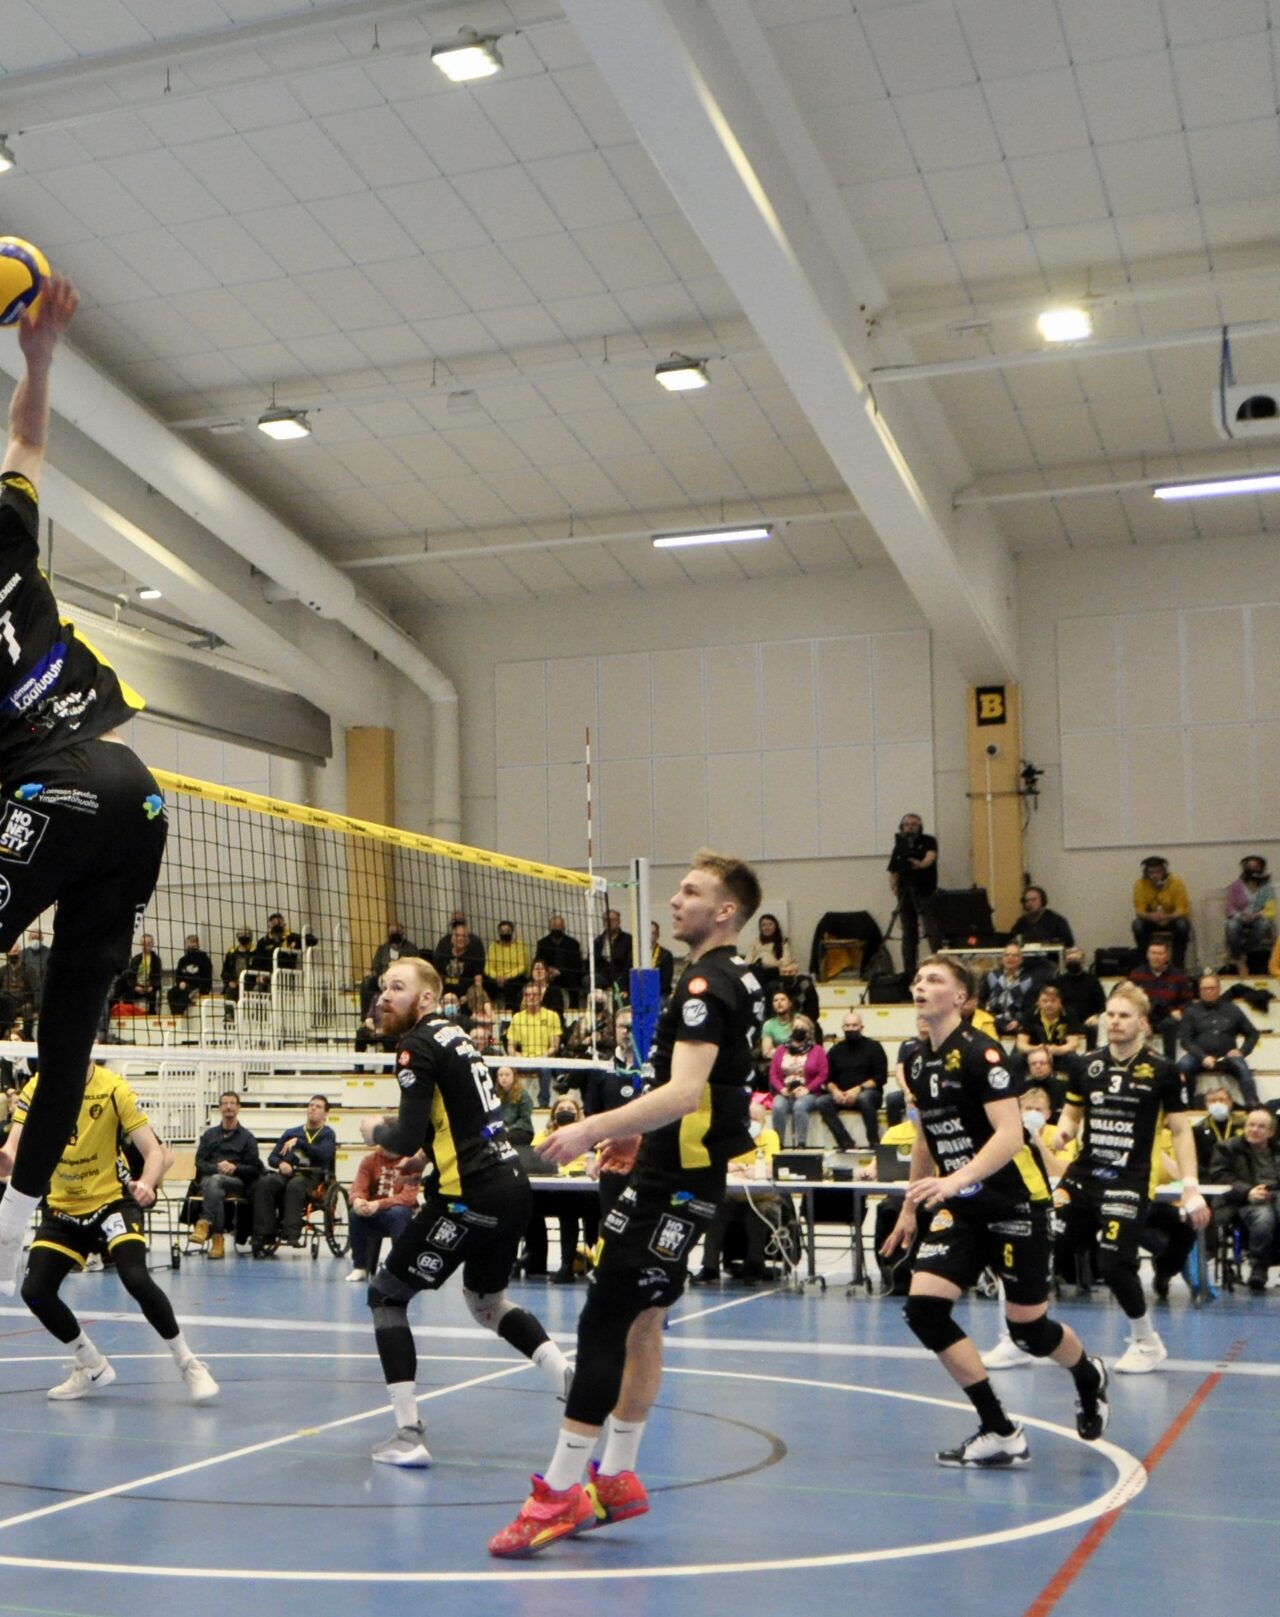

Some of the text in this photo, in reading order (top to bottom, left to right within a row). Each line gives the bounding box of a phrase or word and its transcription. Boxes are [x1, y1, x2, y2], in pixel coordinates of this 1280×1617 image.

[979, 693, 1005, 719] B
[10, 808, 32, 827] HO
[5, 820, 35, 842] NEY
[0, 832, 29, 852] STY
[928, 1072, 940, 1099] 6
[1108, 1074, 1123, 1093] 3
[1089, 1118, 1134, 1133] VALLOX
[665, 1219, 684, 1232] HO
[1105, 1220, 1120, 1241] 3
[657, 1237, 680, 1251] STY
[420, 1256, 441, 1270] BE
[1003, 1243, 1014, 1268] 6
